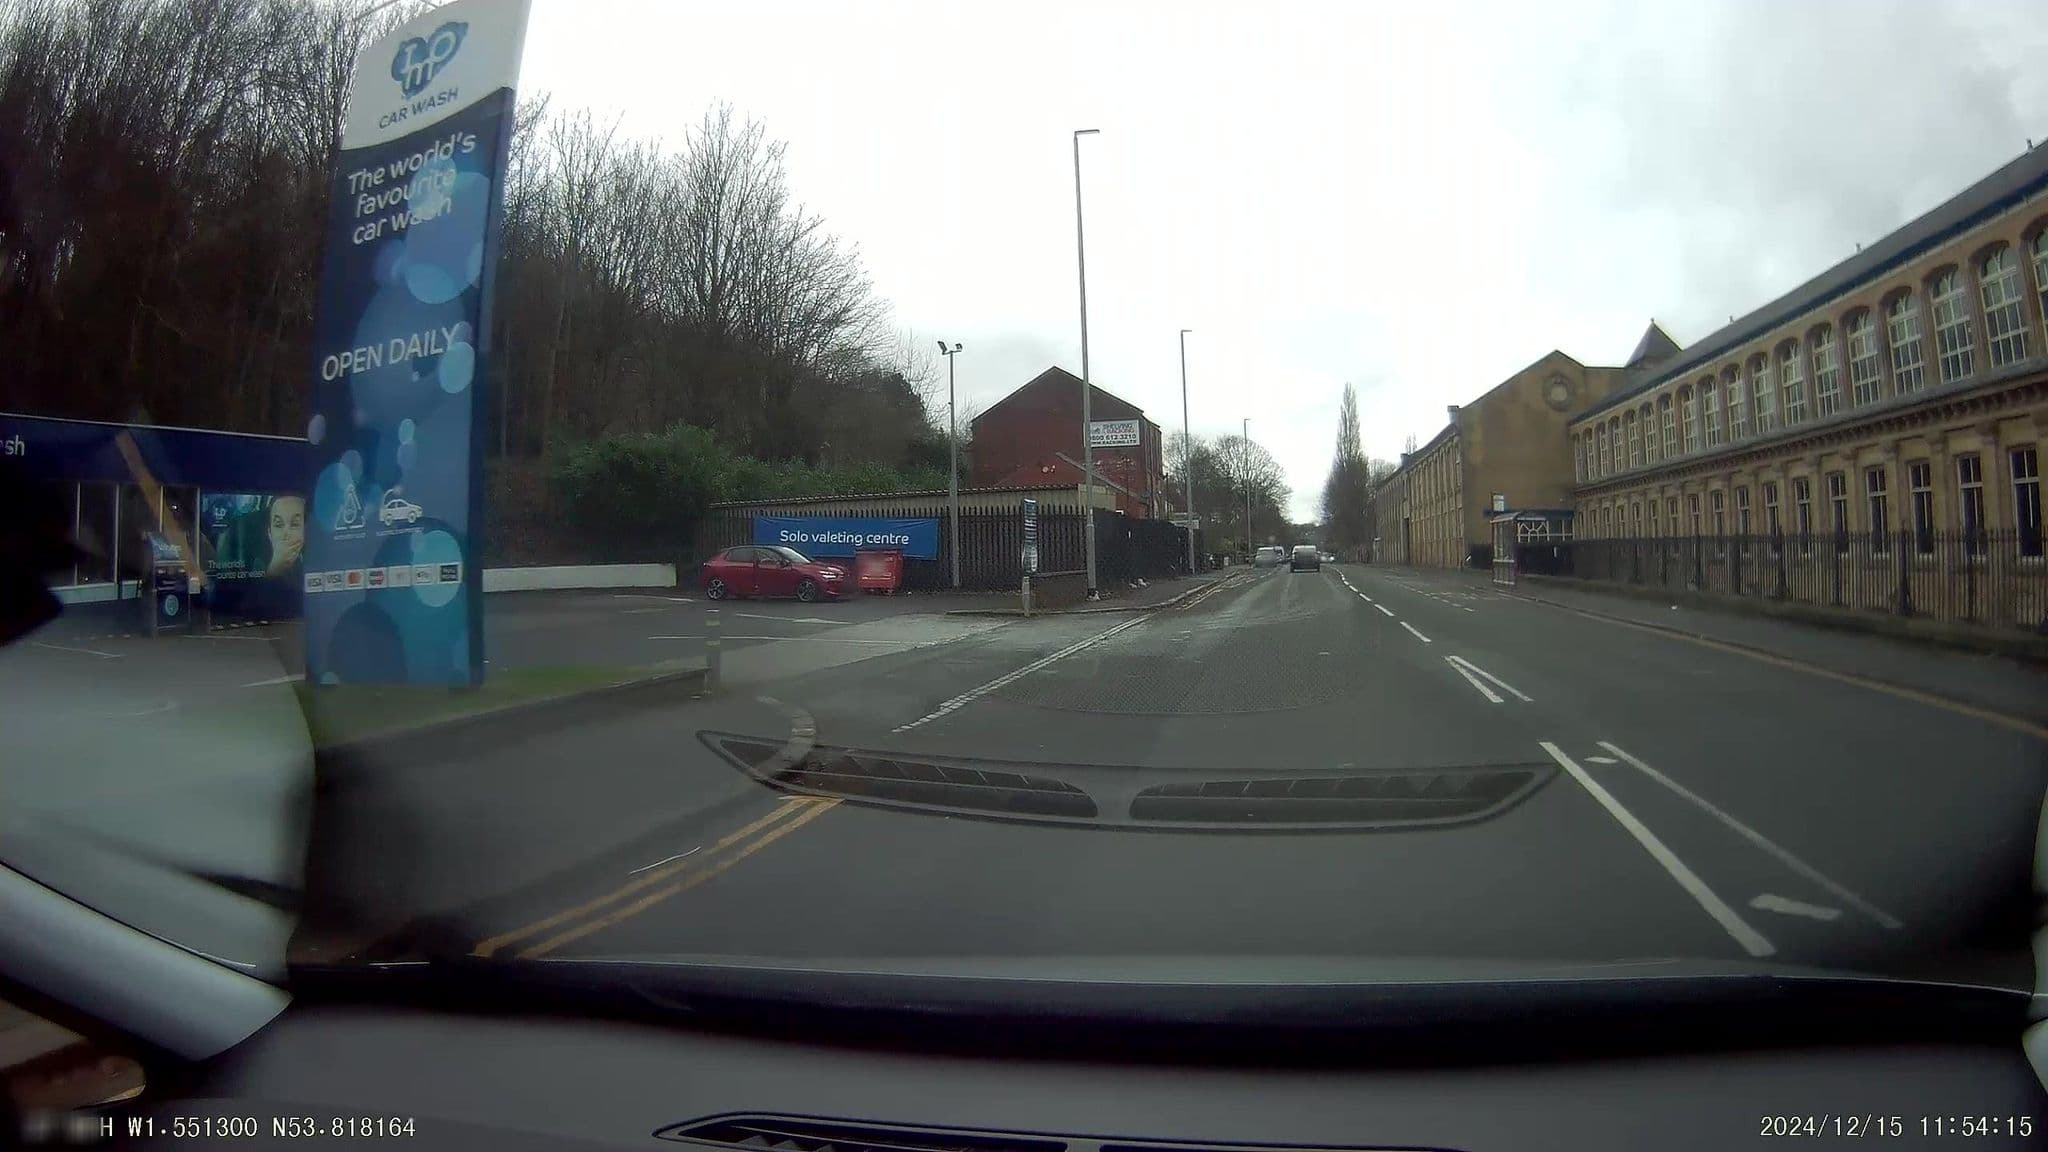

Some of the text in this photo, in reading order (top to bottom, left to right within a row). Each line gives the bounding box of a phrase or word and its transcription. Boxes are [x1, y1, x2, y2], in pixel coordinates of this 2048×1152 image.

[378, 87, 460, 129] CAR WASH
[347, 132, 477, 196] The world's
[355, 167, 457, 218] favourite
[352, 219, 384, 245] car
[321, 328, 460, 382] OPEN DAILY
[779, 530, 910, 547] Solo valeting centre
